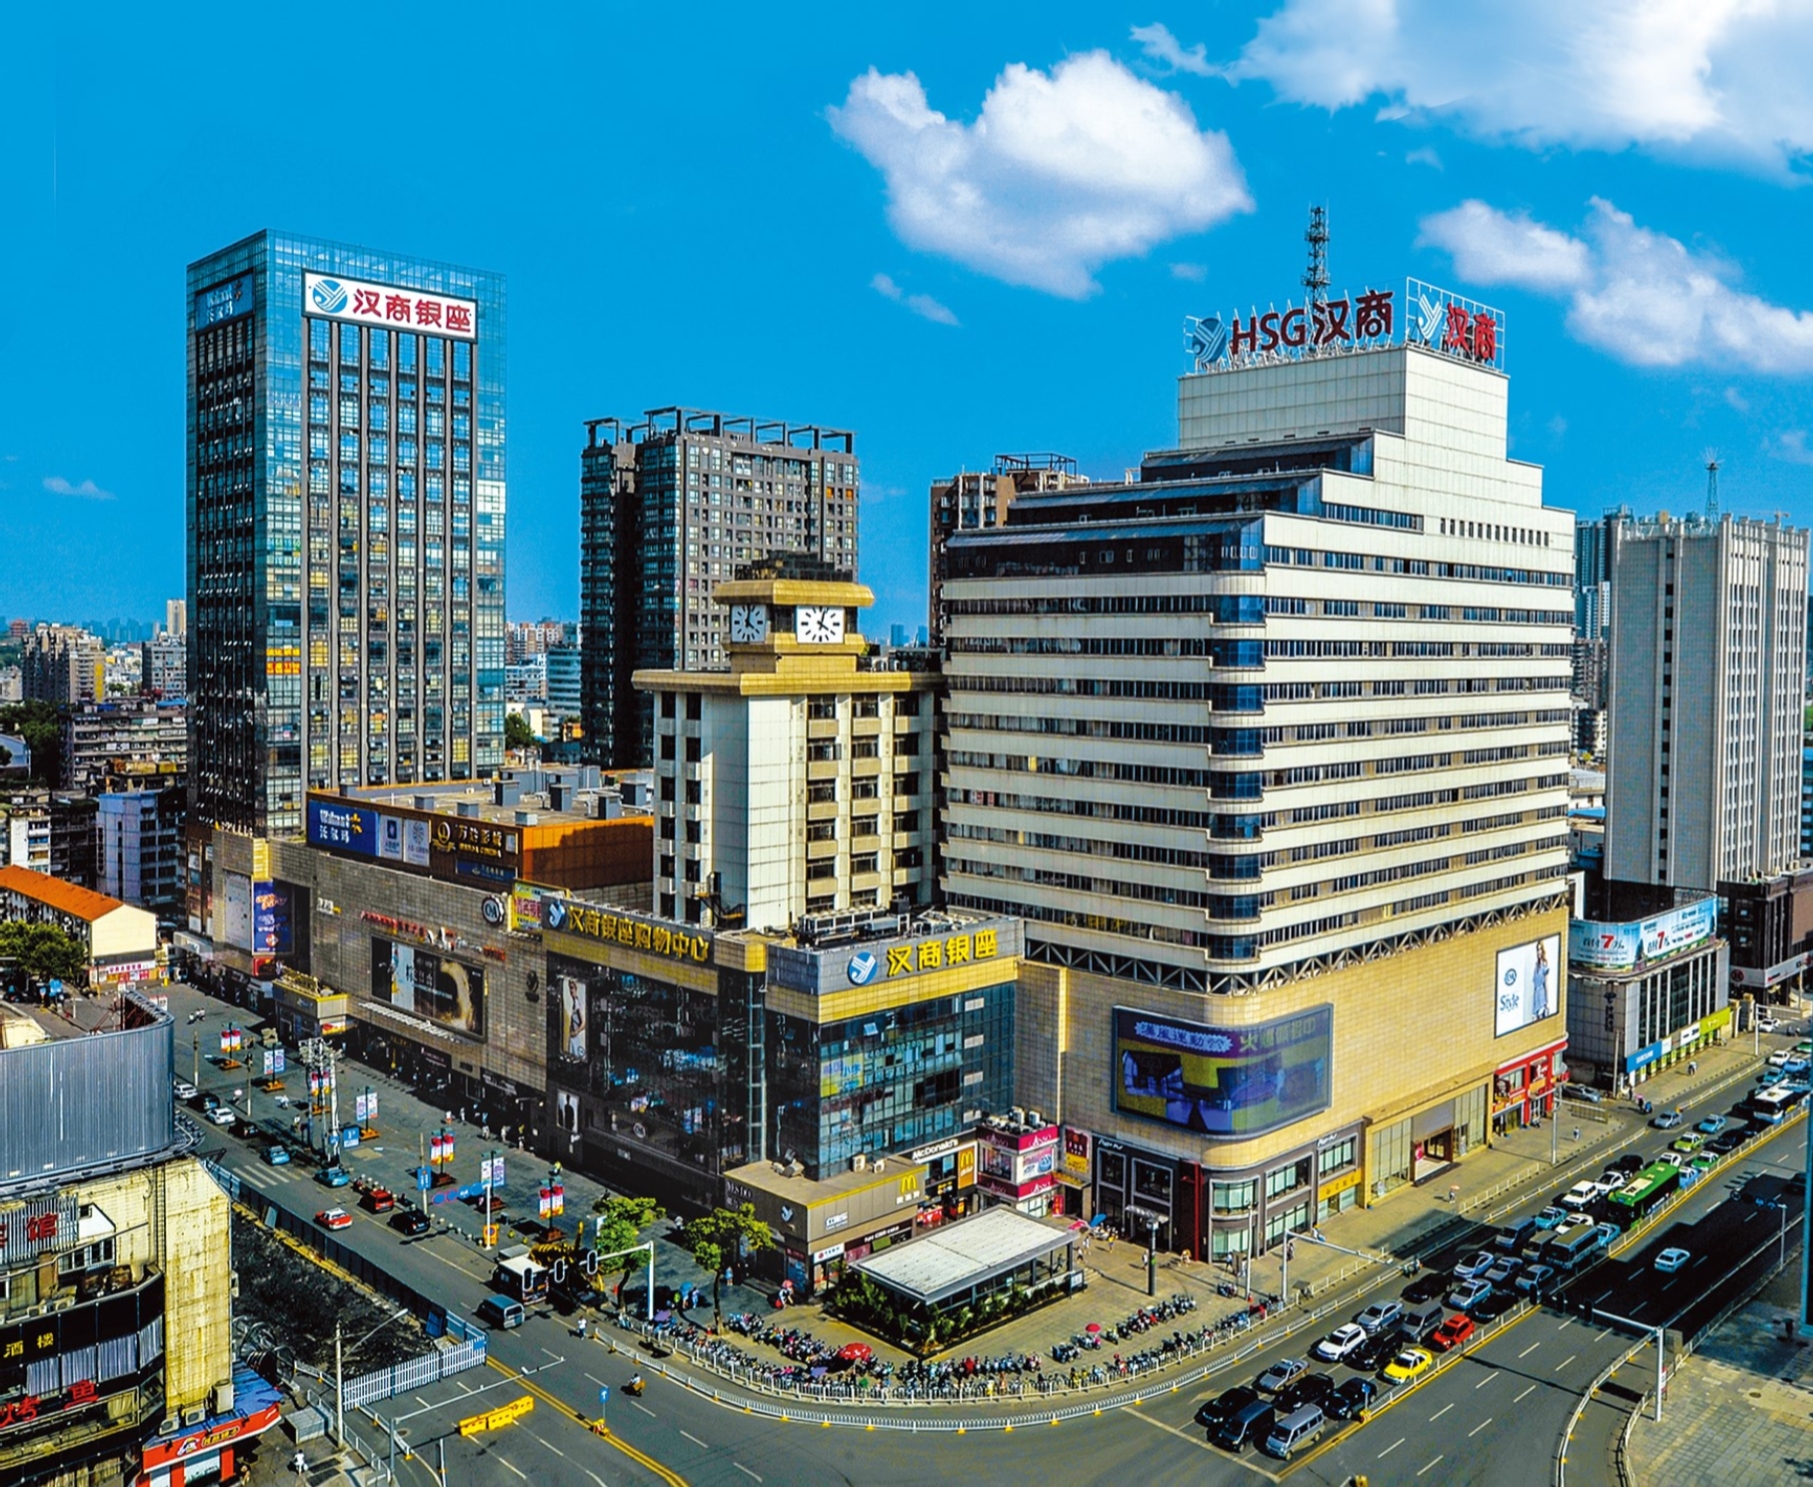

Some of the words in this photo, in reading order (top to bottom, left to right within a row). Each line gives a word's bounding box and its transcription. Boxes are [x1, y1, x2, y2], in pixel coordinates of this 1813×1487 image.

[353, 287, 472, 334] 汉商银座
[1447, 302, 1497, 361] 汉商
[567, 904, 709, 963] 汉商银座购物中心
[886, 926, 999, 977] 汉商银座
[911, 1138, 959, 1162] McDonald's
[3, 1332, 54, 1358] 酒楼
